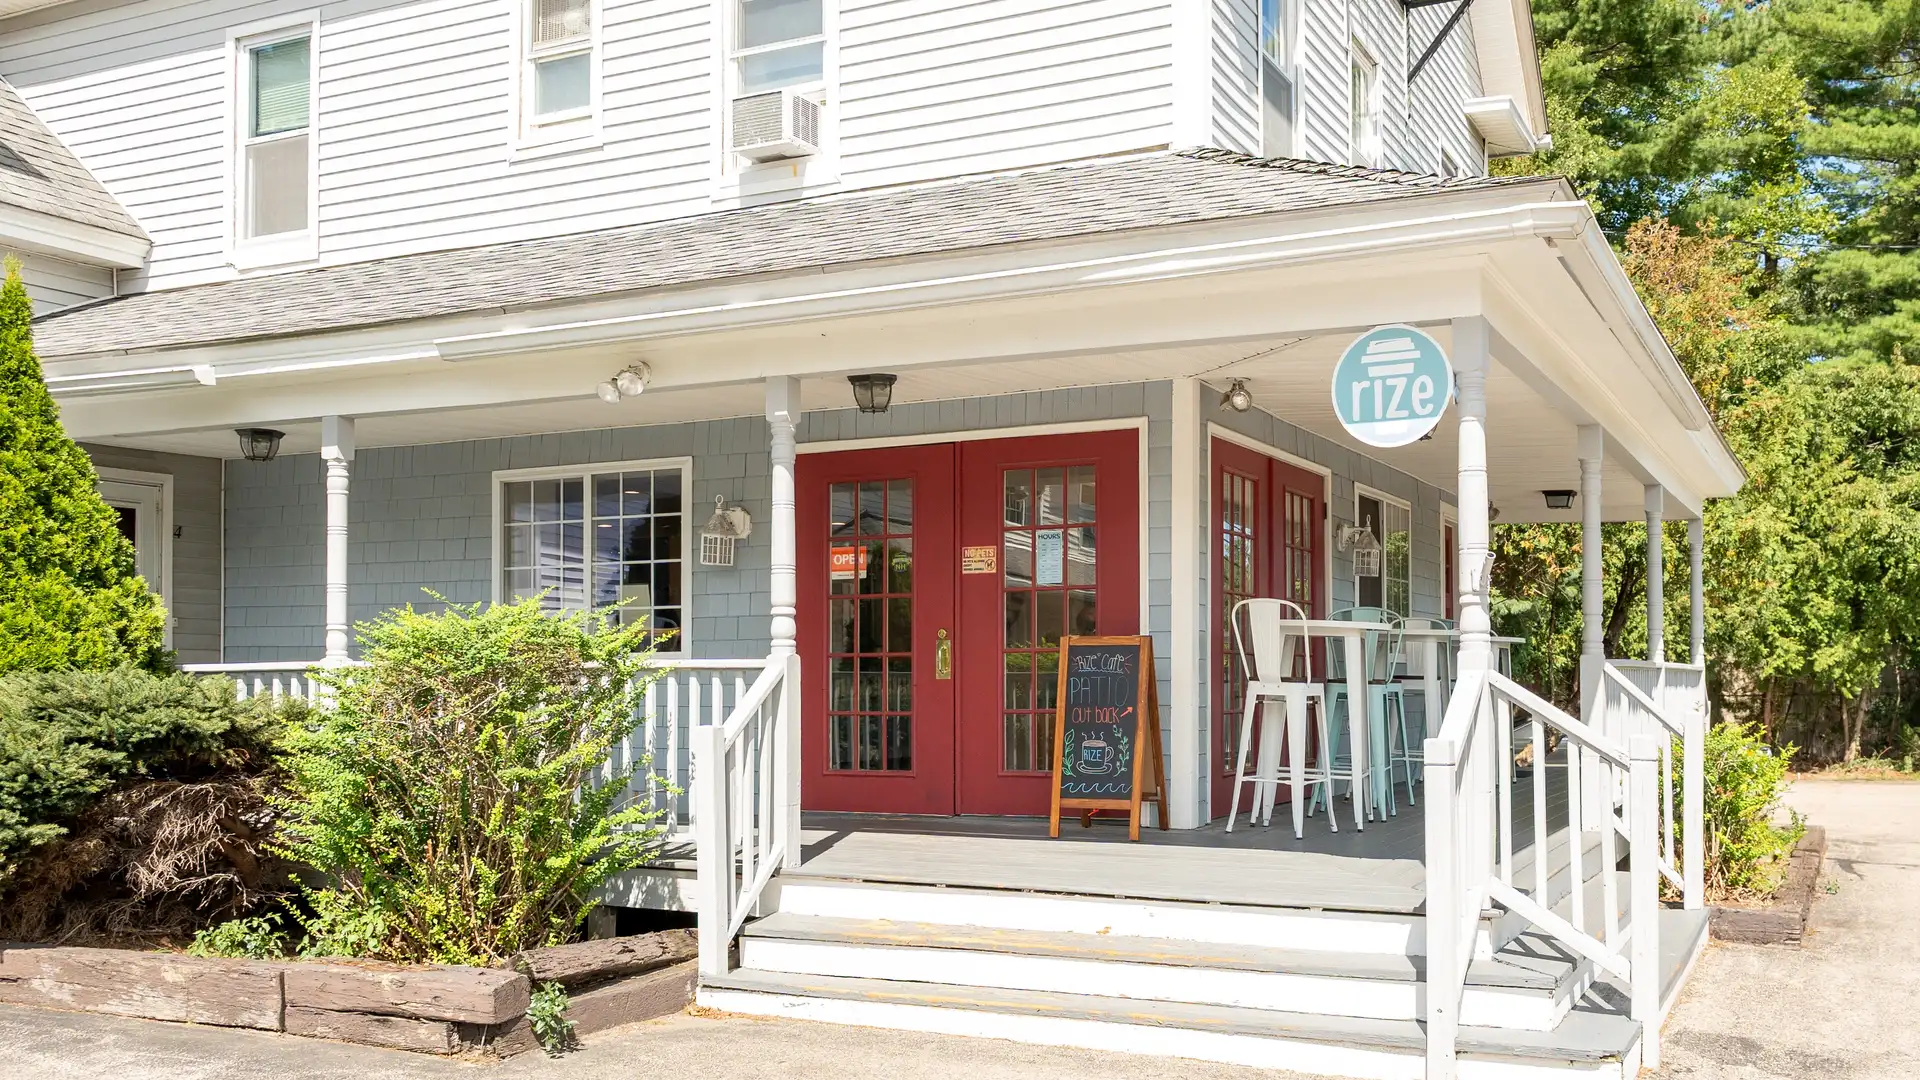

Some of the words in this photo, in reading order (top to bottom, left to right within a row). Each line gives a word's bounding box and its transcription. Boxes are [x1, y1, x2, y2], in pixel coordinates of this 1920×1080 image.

[1352, 374, 1435, 422] rize
[833, 553, 864, 565] OPEN
[964, 549, 974, 558] NO
[1070, 675, 1130, 707] PATIO
[1071, 707, 1091, 724] out
[1095, 706, 1120, 724] back
[1083, 749, 1103, 762] RIZE
